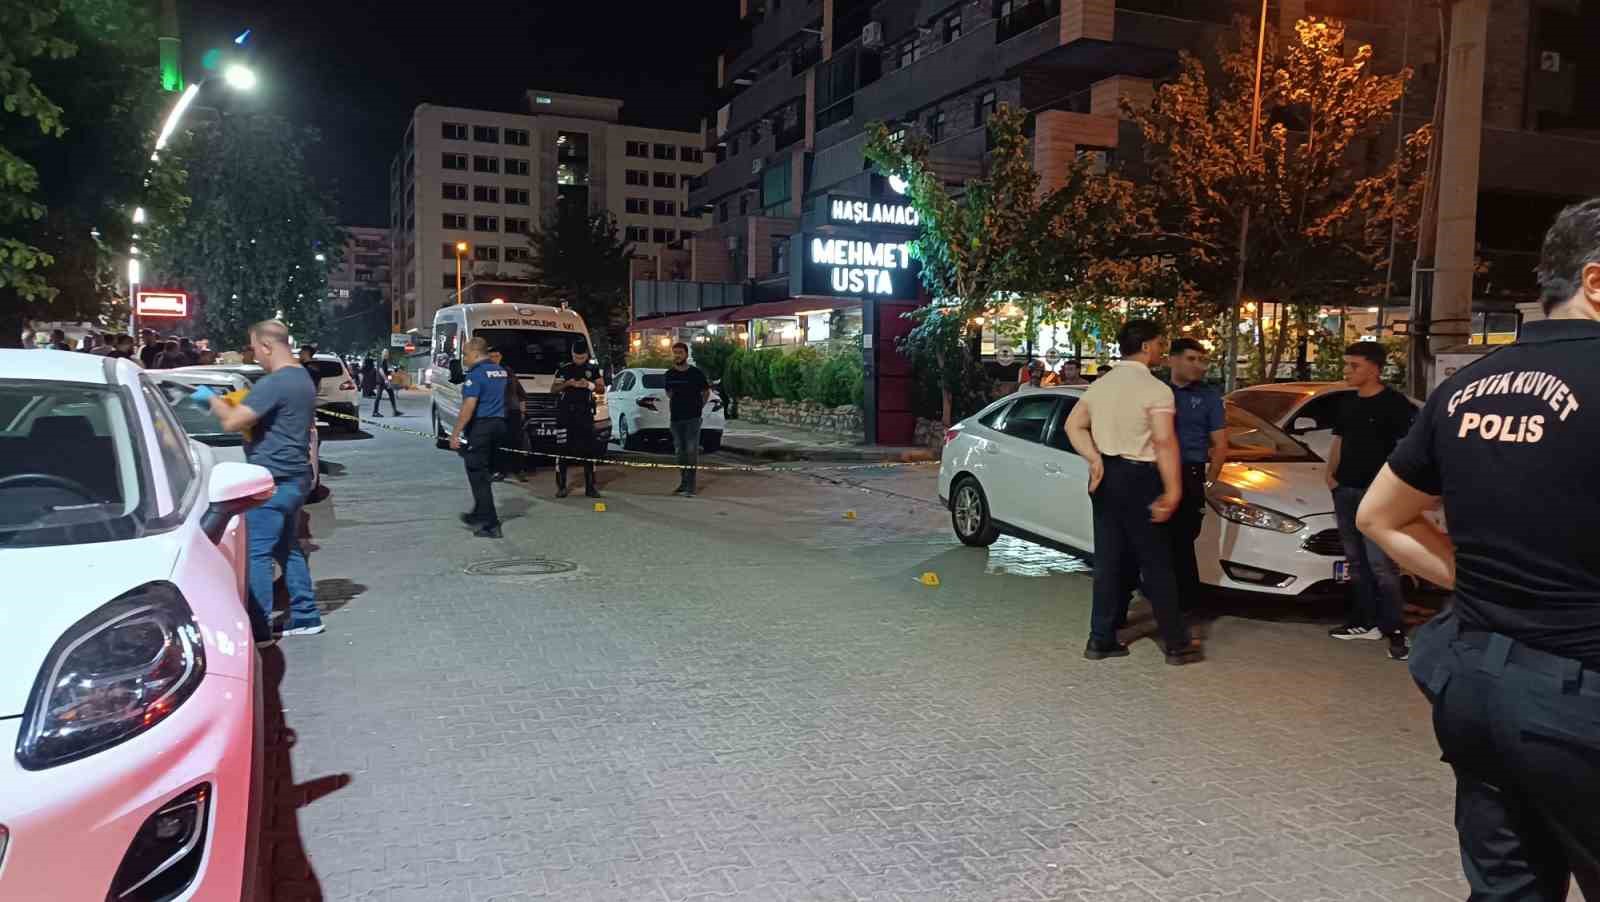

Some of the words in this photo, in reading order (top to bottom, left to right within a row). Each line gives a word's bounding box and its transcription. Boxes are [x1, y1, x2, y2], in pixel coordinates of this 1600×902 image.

[812, 238, 909, 269] MEHMET
[831, 267, 893, 295] USTA
[481, 319, 501, 327] OLAY
[1511, 371, 1580, 422] KUVVET
